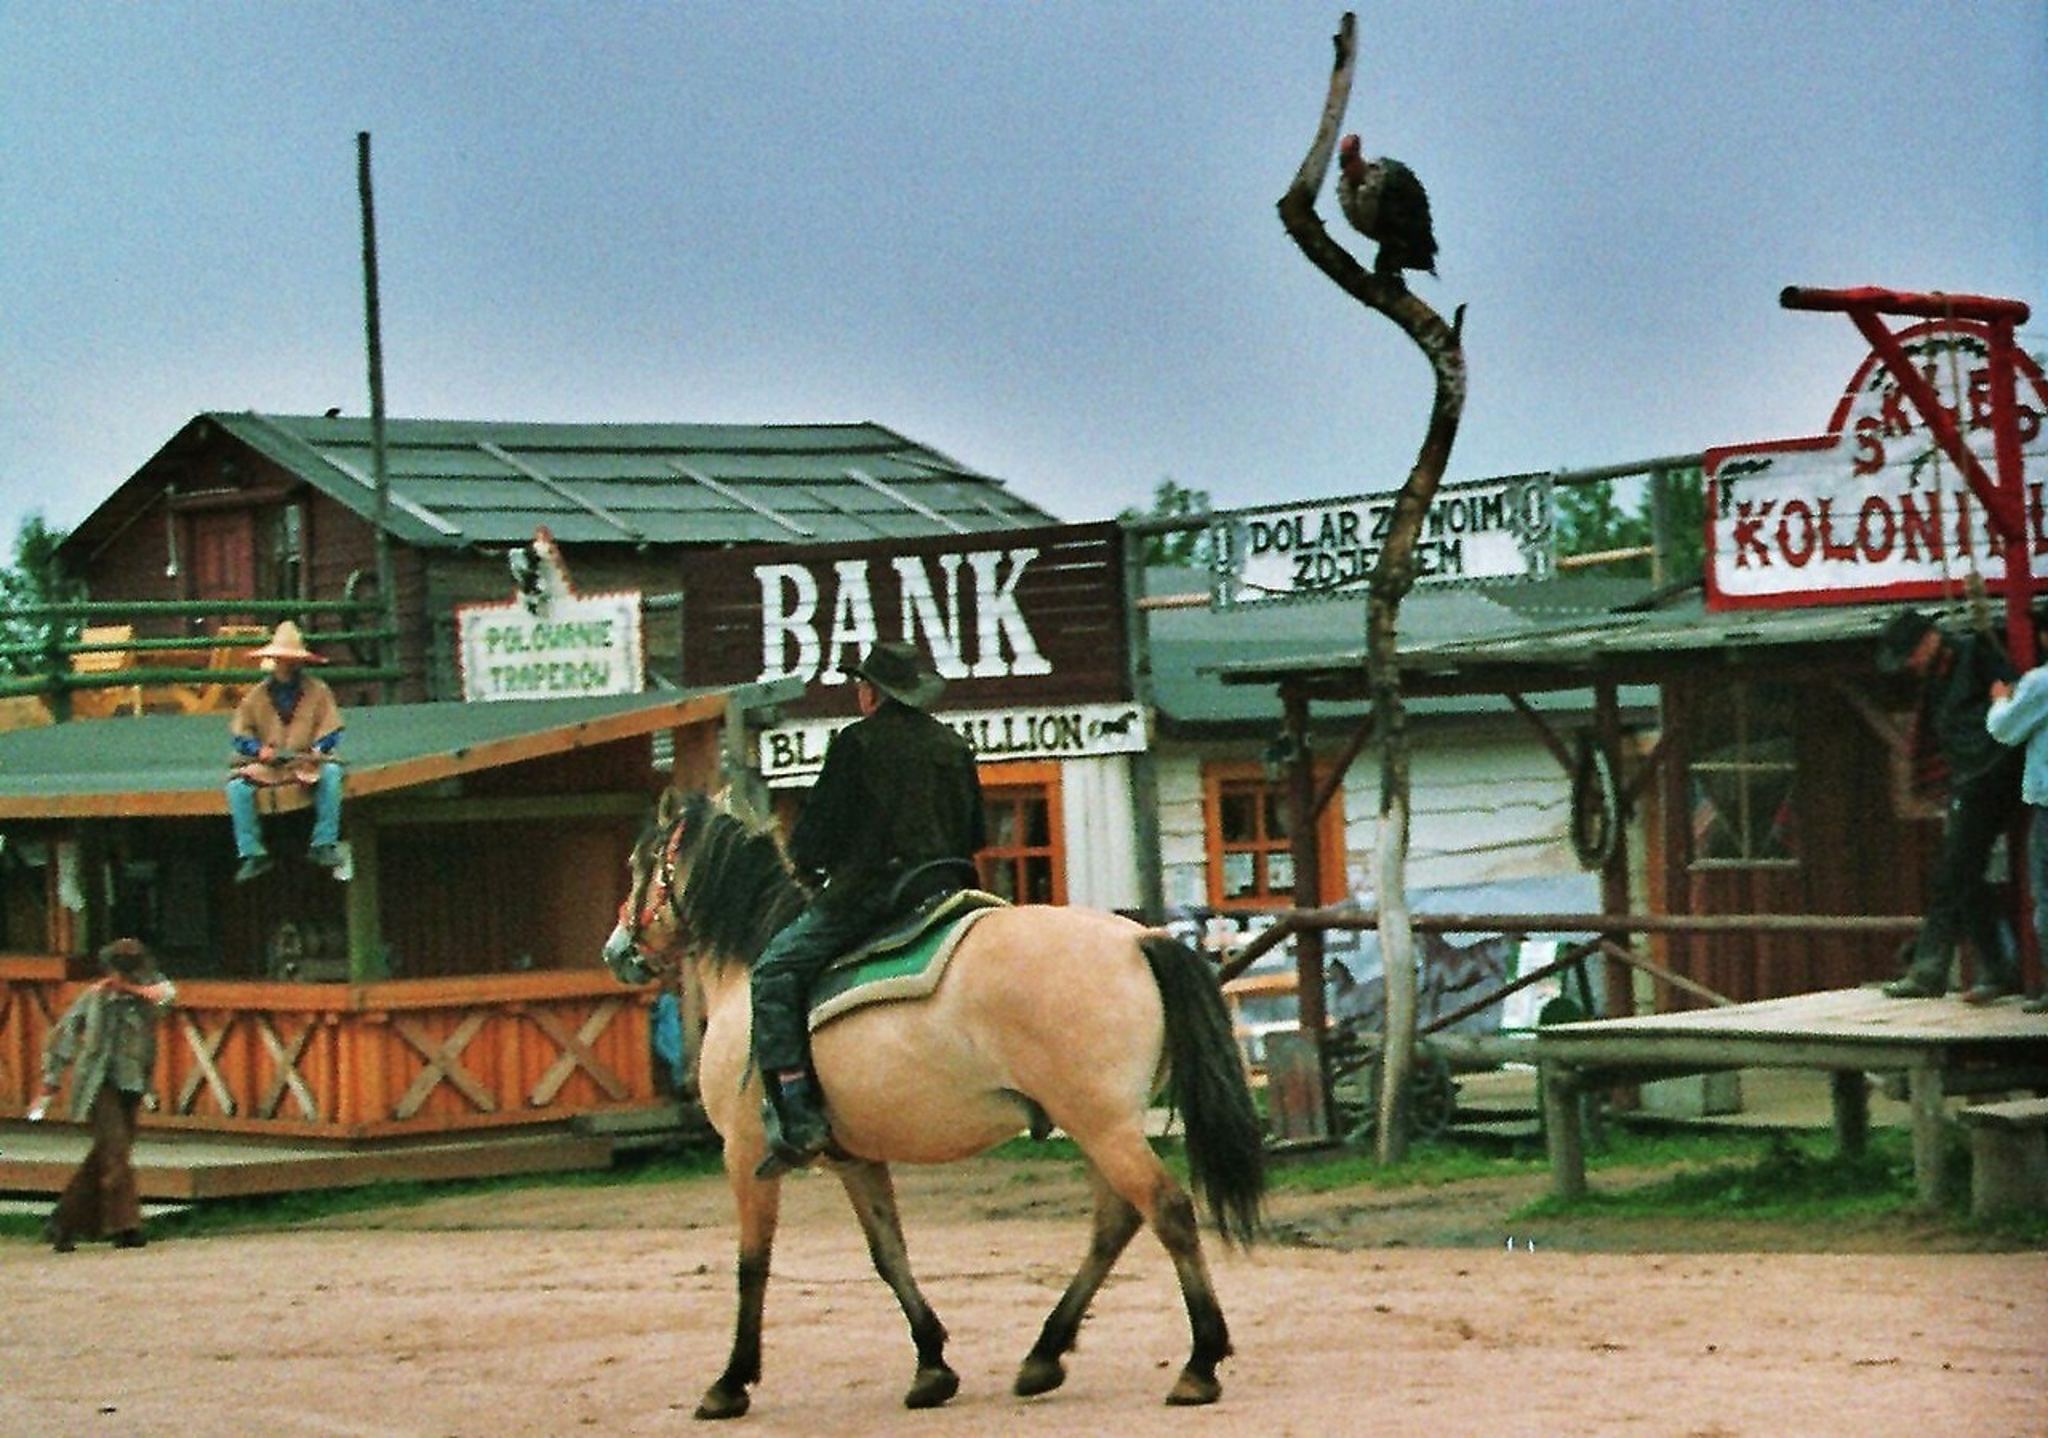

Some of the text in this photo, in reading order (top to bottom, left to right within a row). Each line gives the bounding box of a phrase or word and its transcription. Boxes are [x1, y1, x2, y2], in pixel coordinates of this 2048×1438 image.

[1249, 511, 1359, 554] DOLAR
[1734, 482, 2048, 568] KOLONIL
[754, 548, 1053, 686] BANK
